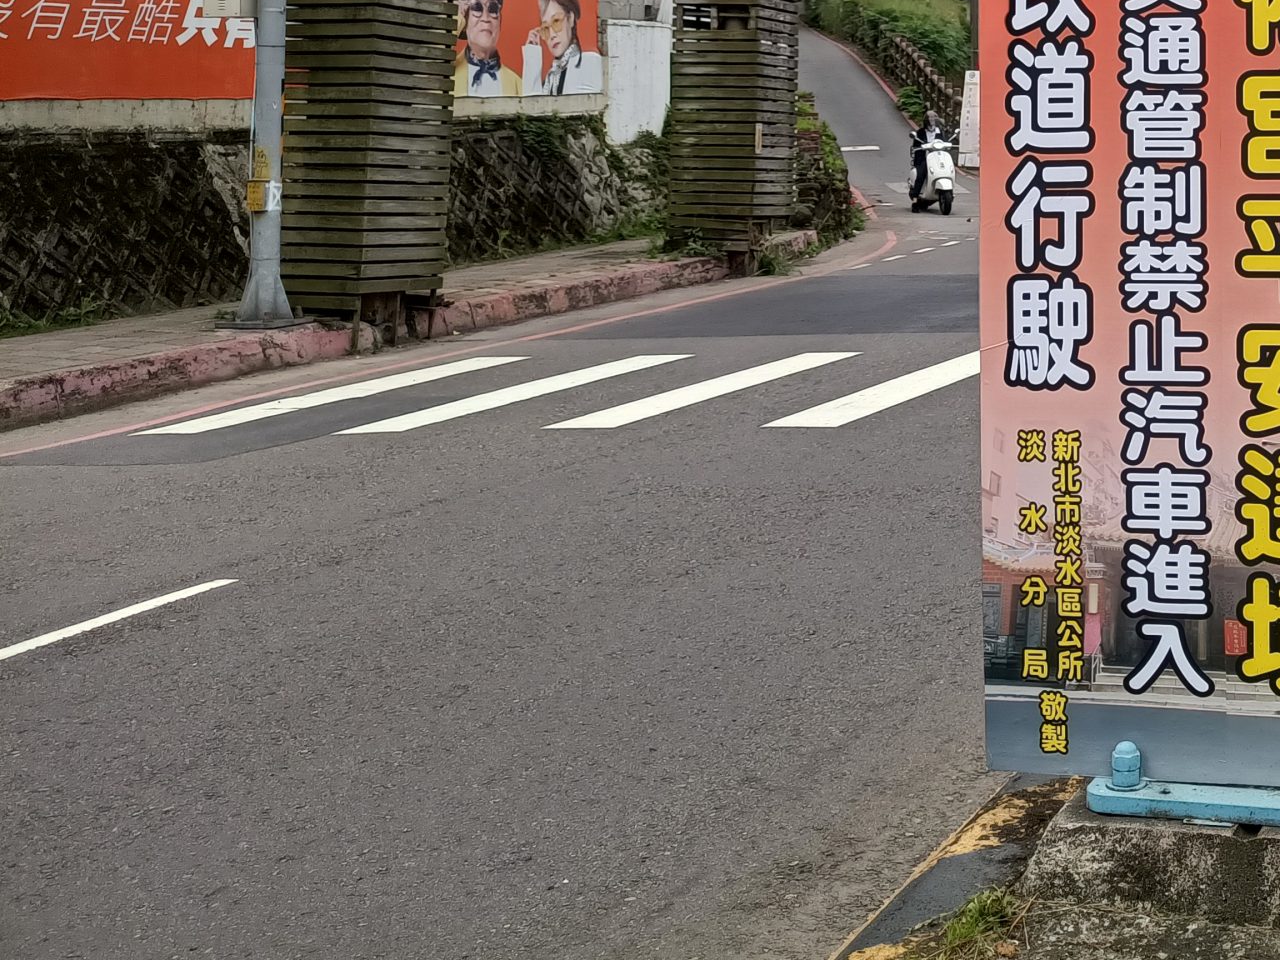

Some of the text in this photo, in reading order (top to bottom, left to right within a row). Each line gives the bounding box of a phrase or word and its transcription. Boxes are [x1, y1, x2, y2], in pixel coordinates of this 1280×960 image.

[1052, 429, 1084, 682] 新北市淡水區公所
[1039, 690, 1068, 755] 敬製
